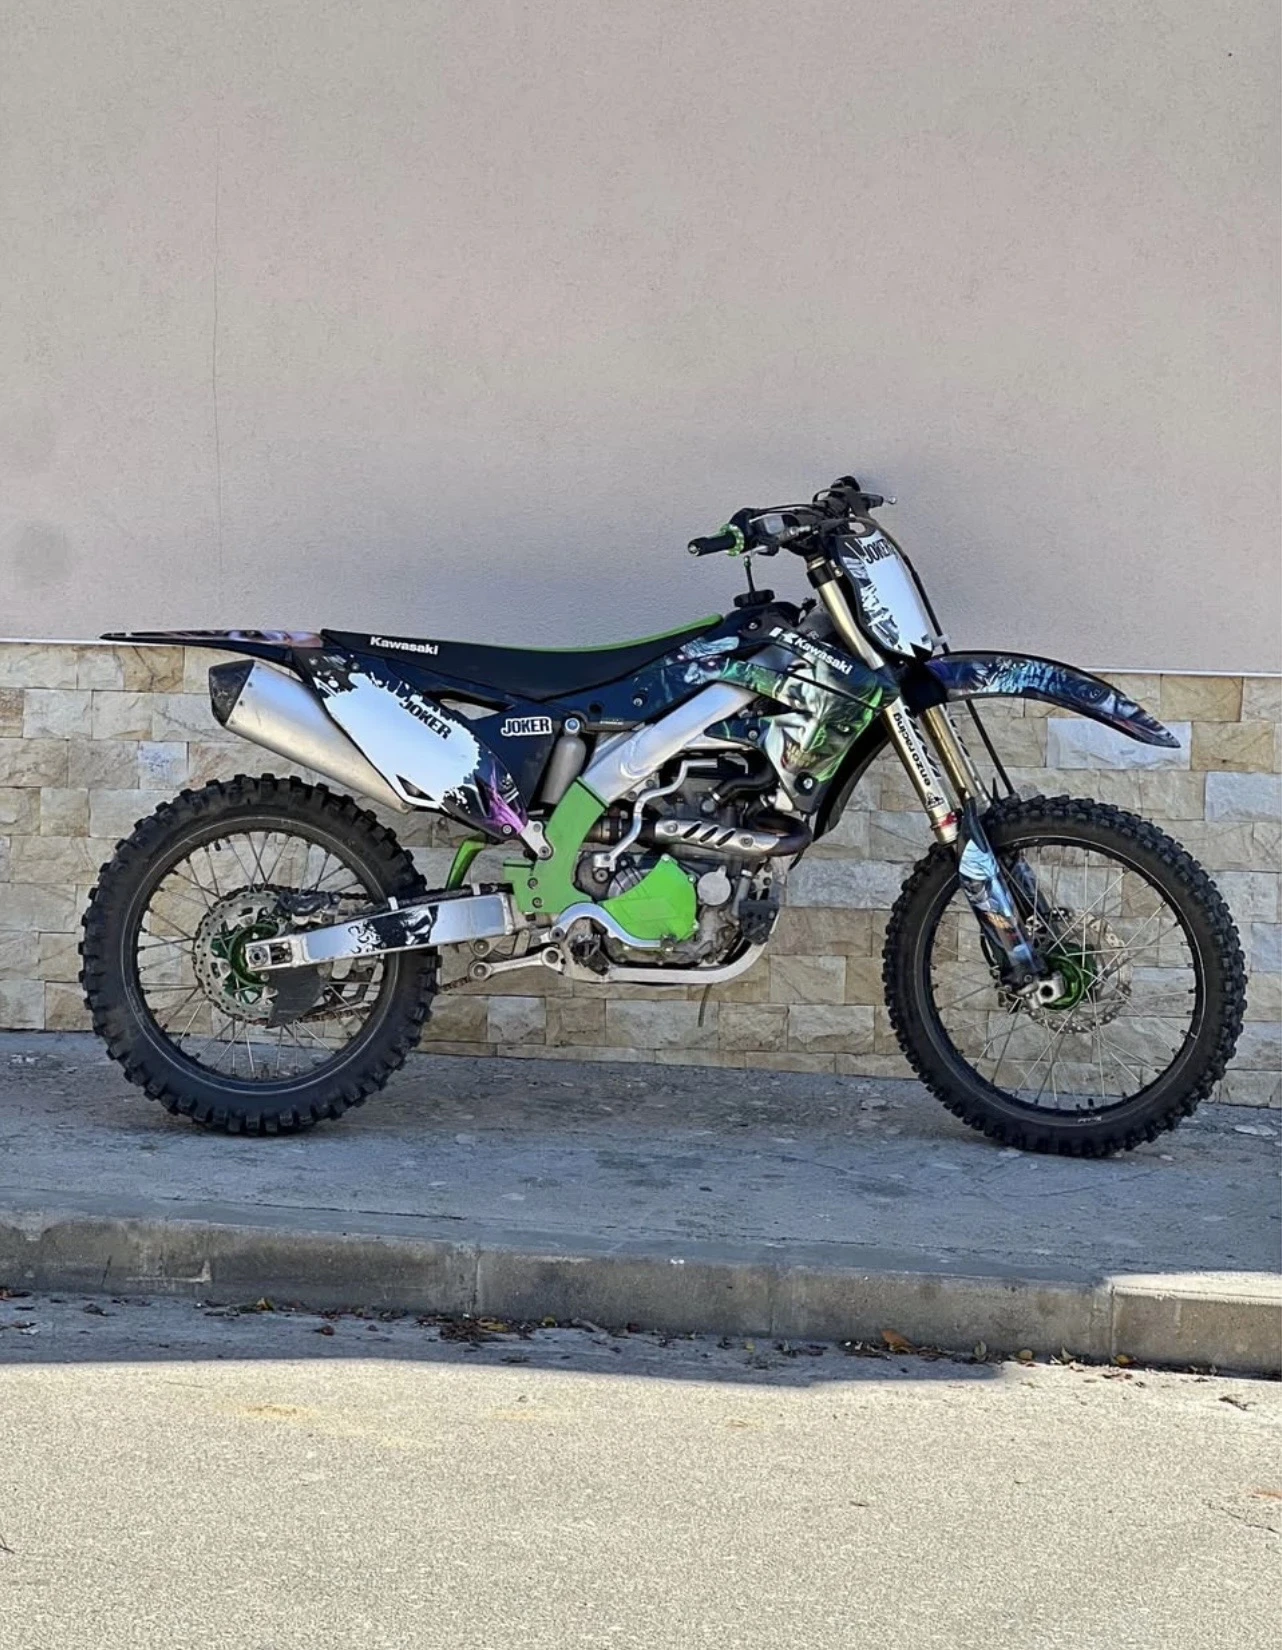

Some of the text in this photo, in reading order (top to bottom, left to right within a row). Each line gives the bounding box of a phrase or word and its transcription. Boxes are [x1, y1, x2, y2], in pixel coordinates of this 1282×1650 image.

[370, 636, 439, 655] Kawasaki
[794, 637, 853, 675] Kawasaki
[399, 700, 452, 740] JOKER
[502, 718, 551, 735] JOKER
